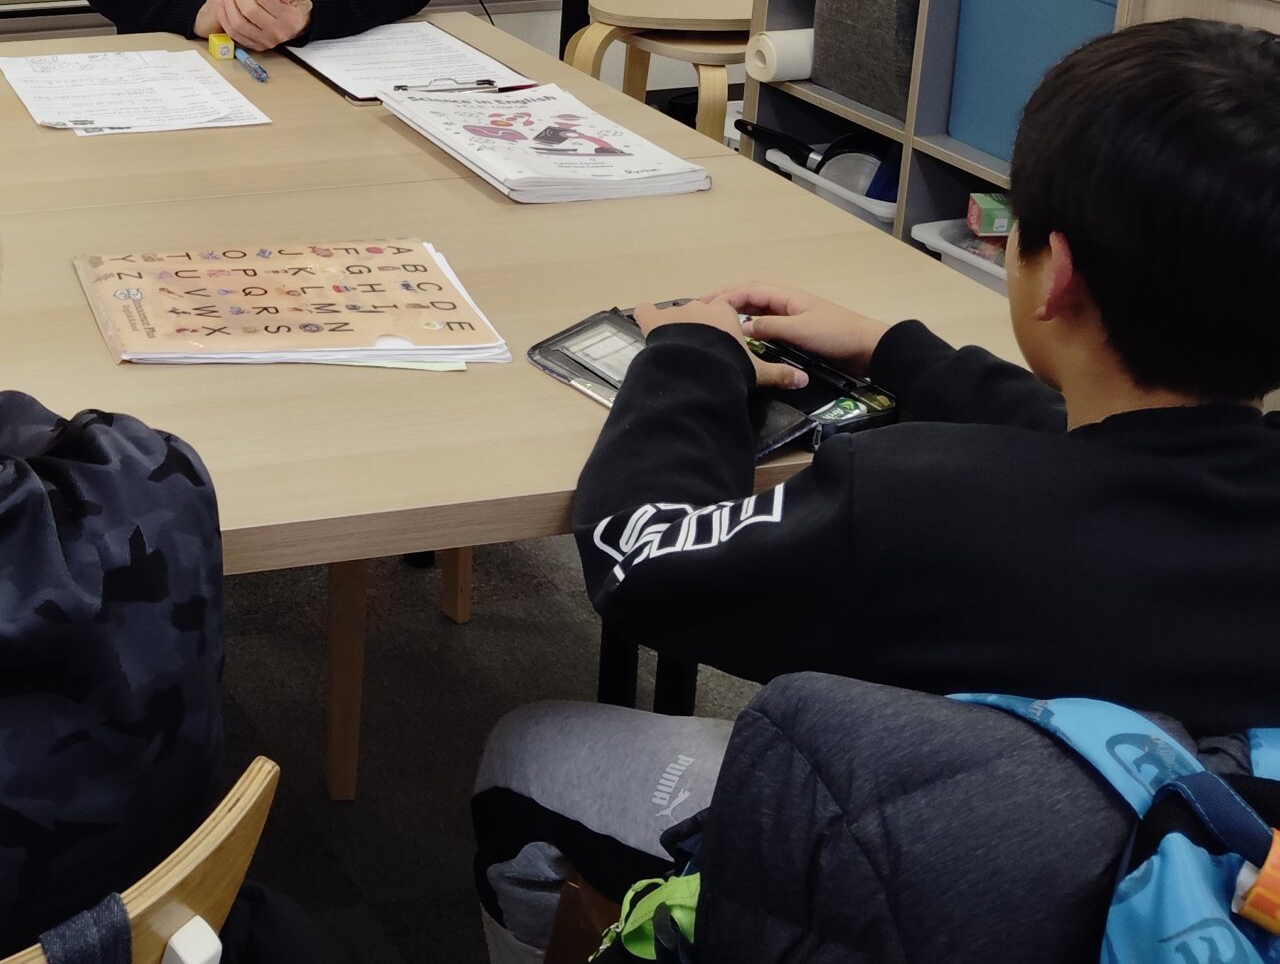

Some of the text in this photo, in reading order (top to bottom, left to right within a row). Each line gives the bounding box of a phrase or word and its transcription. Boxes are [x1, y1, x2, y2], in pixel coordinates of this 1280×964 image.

[407, 95, 472, 105] Science
[493, 95, 557, 106] English
[333, 247, 360, 255] F
[110, 254, 143, 280] Y Z
[288, 267, 315, 276] K
[346, 265, 372, 274] G
[222, 250, 291, 334] O P Q R S
[300, 286, 324, 294] L
[357, 284, 386, 293] H
[387, 245, 475, 331] A B C D E
[166, 252, 231, 336] T U V W X
[311, 303, 341, 313] M
[324, 322, 354, 332] N
[651, 754, 696, 806] PUMA
